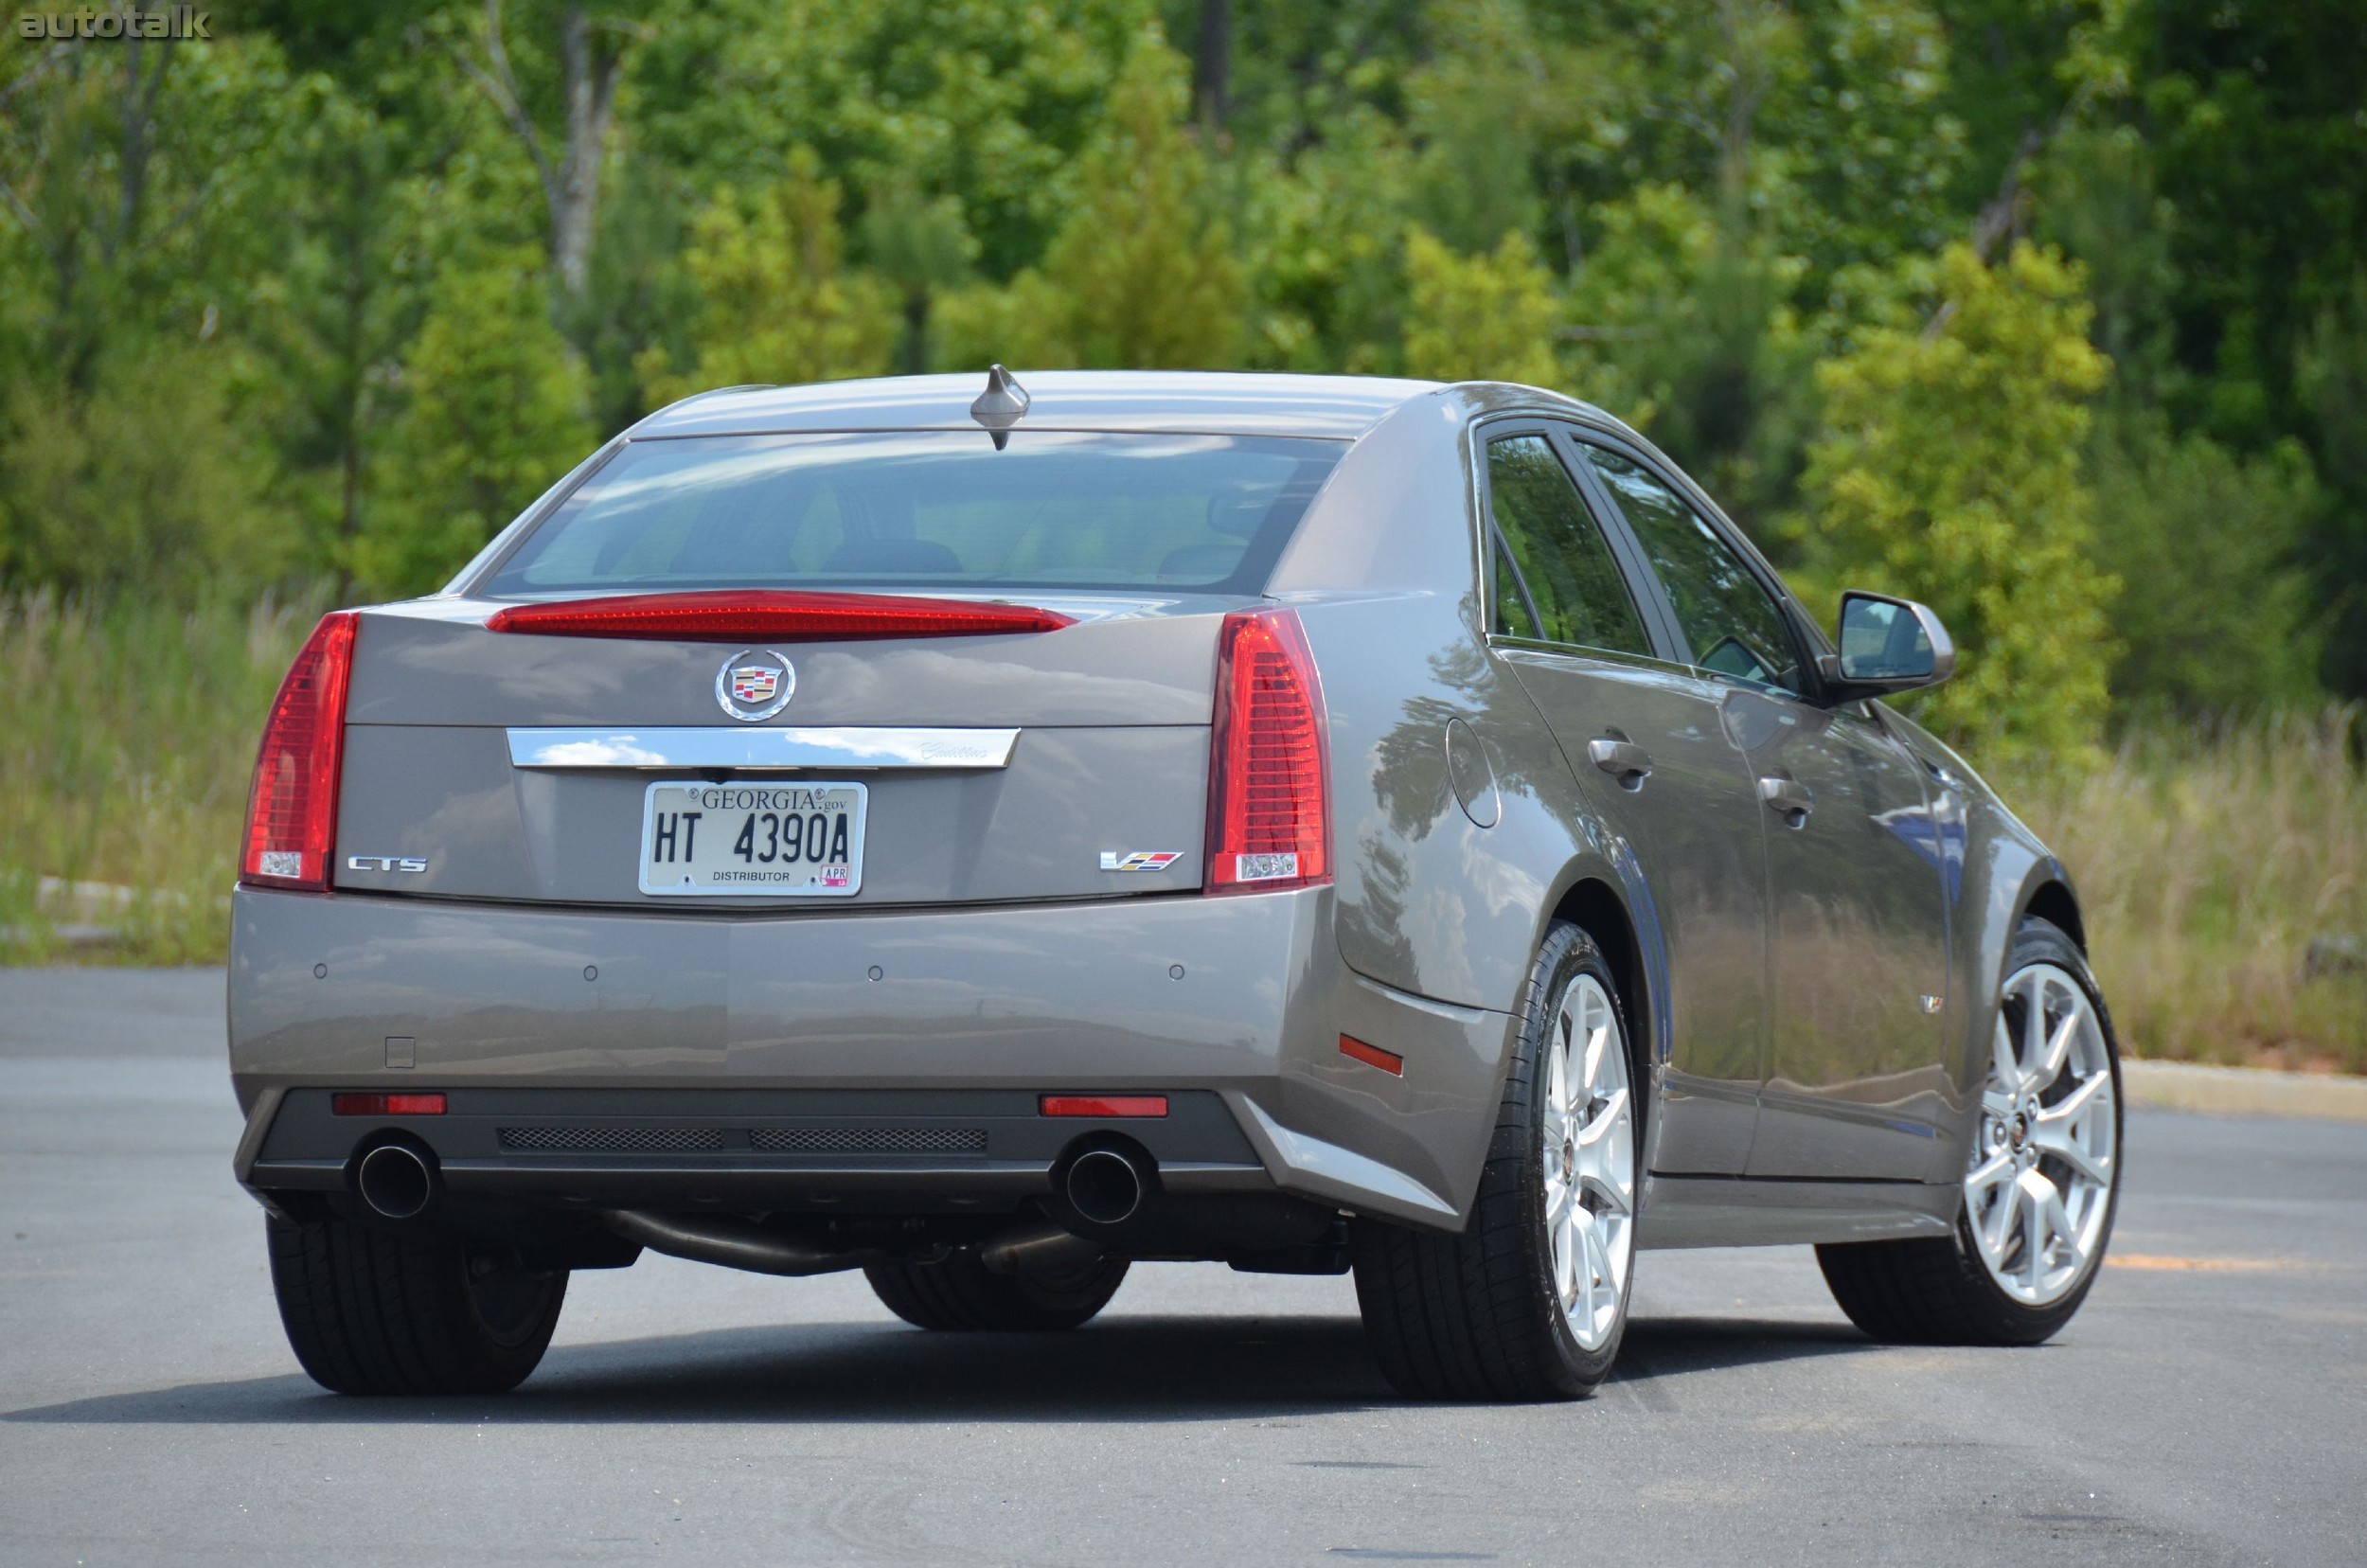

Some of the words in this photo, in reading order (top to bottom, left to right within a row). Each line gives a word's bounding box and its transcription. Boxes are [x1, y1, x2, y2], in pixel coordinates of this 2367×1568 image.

[654, 812, 703, 863] HT
[734, 812, 848, 863] 4390A
[348, 856, 427, 872] CTS
[713, 871, 790, 882] DISTRIBUTOR
[826, 868, 845, 879] APR
